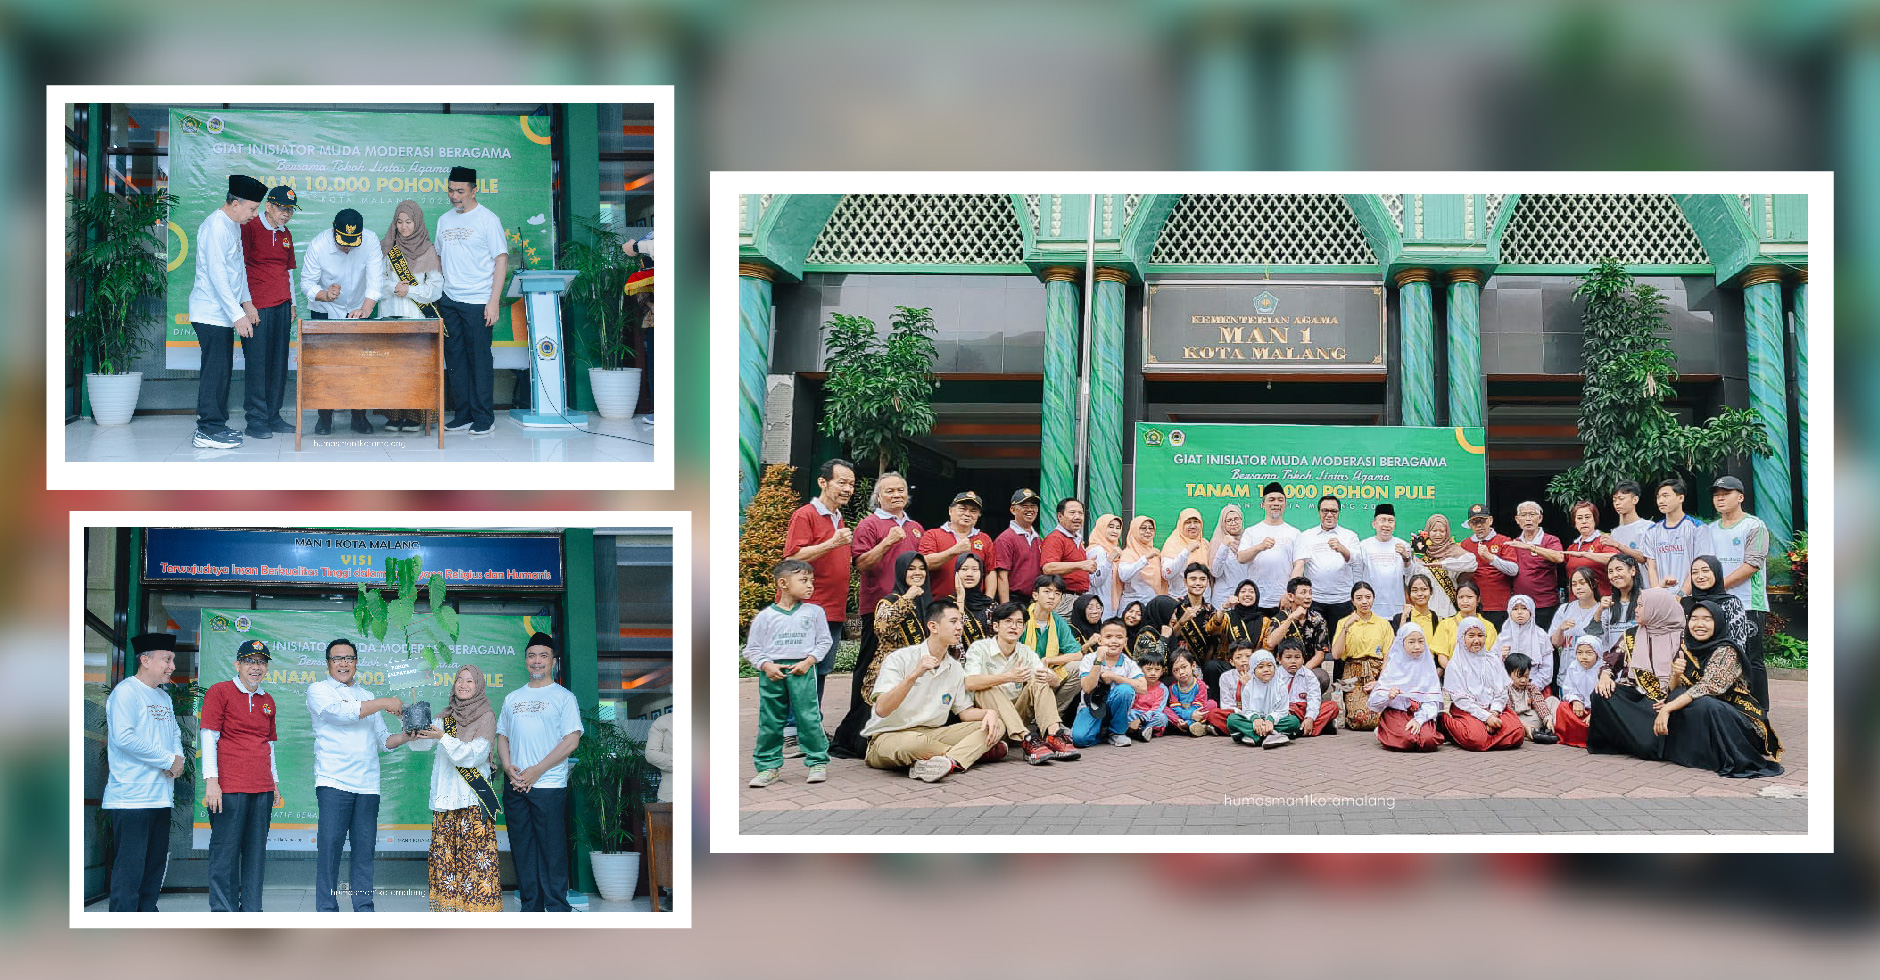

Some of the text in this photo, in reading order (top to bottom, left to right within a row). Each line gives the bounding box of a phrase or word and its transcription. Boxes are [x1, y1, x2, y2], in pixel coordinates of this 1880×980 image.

[212, 143, 512, 159] GIAT INISIATOR MUDA MODERASI BERAGAMA
[275, 159, 328, 171] Bersama
[369, 160, 405, 173] Lintas
[408, 161, 451, 177] Agama
[305, 176, 370, 192] 10.000
[377, 177, 448, 193] POHON
[1190, 315, 1339, 324] KEMENTERIAN AGAMA
[1218, 326, 1313, 344] MAN 1
[1182, 346, 1348, 360] KOTA MALANG
[1173, 453, 1448, 467] GIAT INISIATOR MUDA MODERASI BERAGAMA
[1230, 468, 1392, 484] Bersama Tokoh Lintas Agama
[1185, 483, 1250, 498] TANAM
[1322, 485, 1389, 500] POHON
[1394, 485, 1436, 500] PULE
[295, 538, 421, 550] MAN 1 KOTA MALANG
[340, 554, 372, 566] VISI
[160, 562, 229, 576] Terwujudnya
[231, 564, 258, 576] Insan
[260, 565, 318, 577] Berkualitas
[321, 567, 351, 578] Tinggi
[444, 569, 483, 581] Religius
[484, 569, 505, 580] dan
[506, 569, 552, 580] Humanis
[273, 641, 327, 652] INISIATO
[448, 644, 516, 655] BERAGAMA
[262, 670, 317, 684] ANAM
